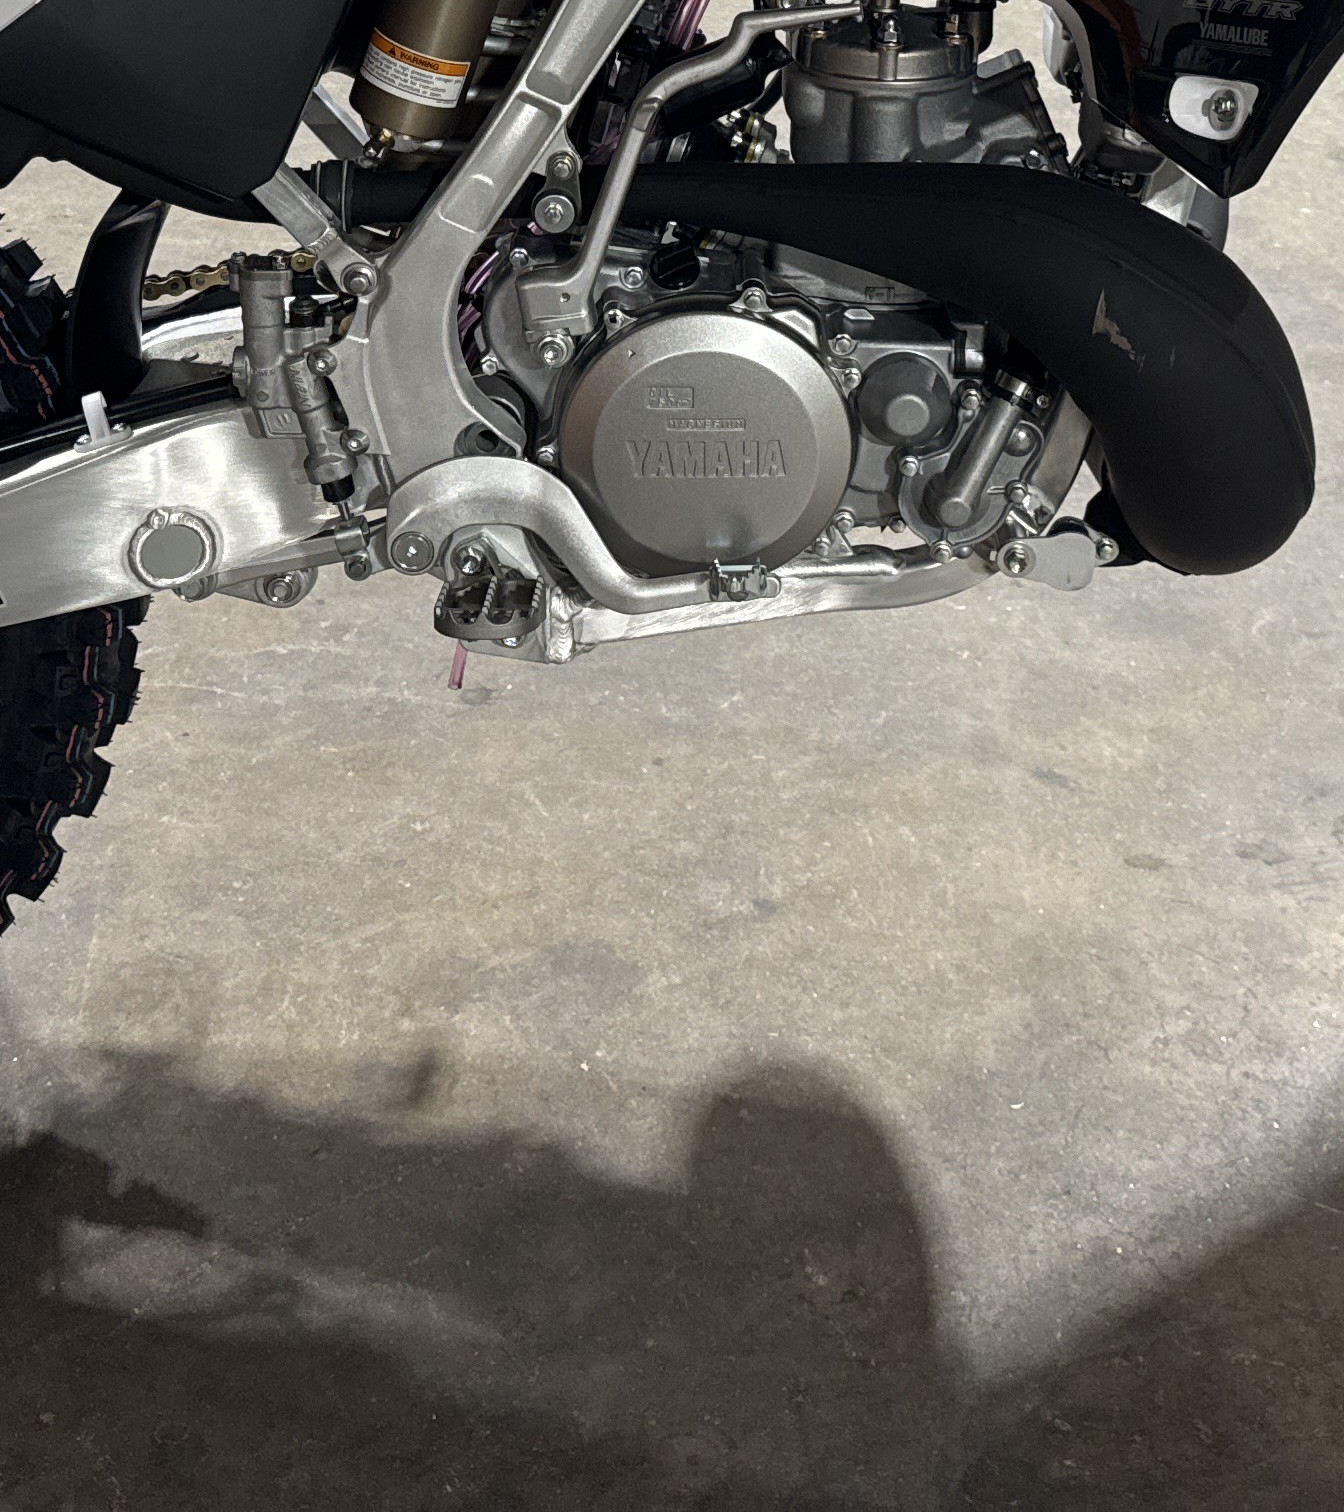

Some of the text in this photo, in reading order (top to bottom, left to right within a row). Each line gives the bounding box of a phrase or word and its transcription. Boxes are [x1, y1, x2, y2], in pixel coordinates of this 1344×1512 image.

[1200, 21, 1269, 47] YAMALUBE
[400, 51, 440, 71] WARNING
[626, 438, 788, 478] YAMAHA
